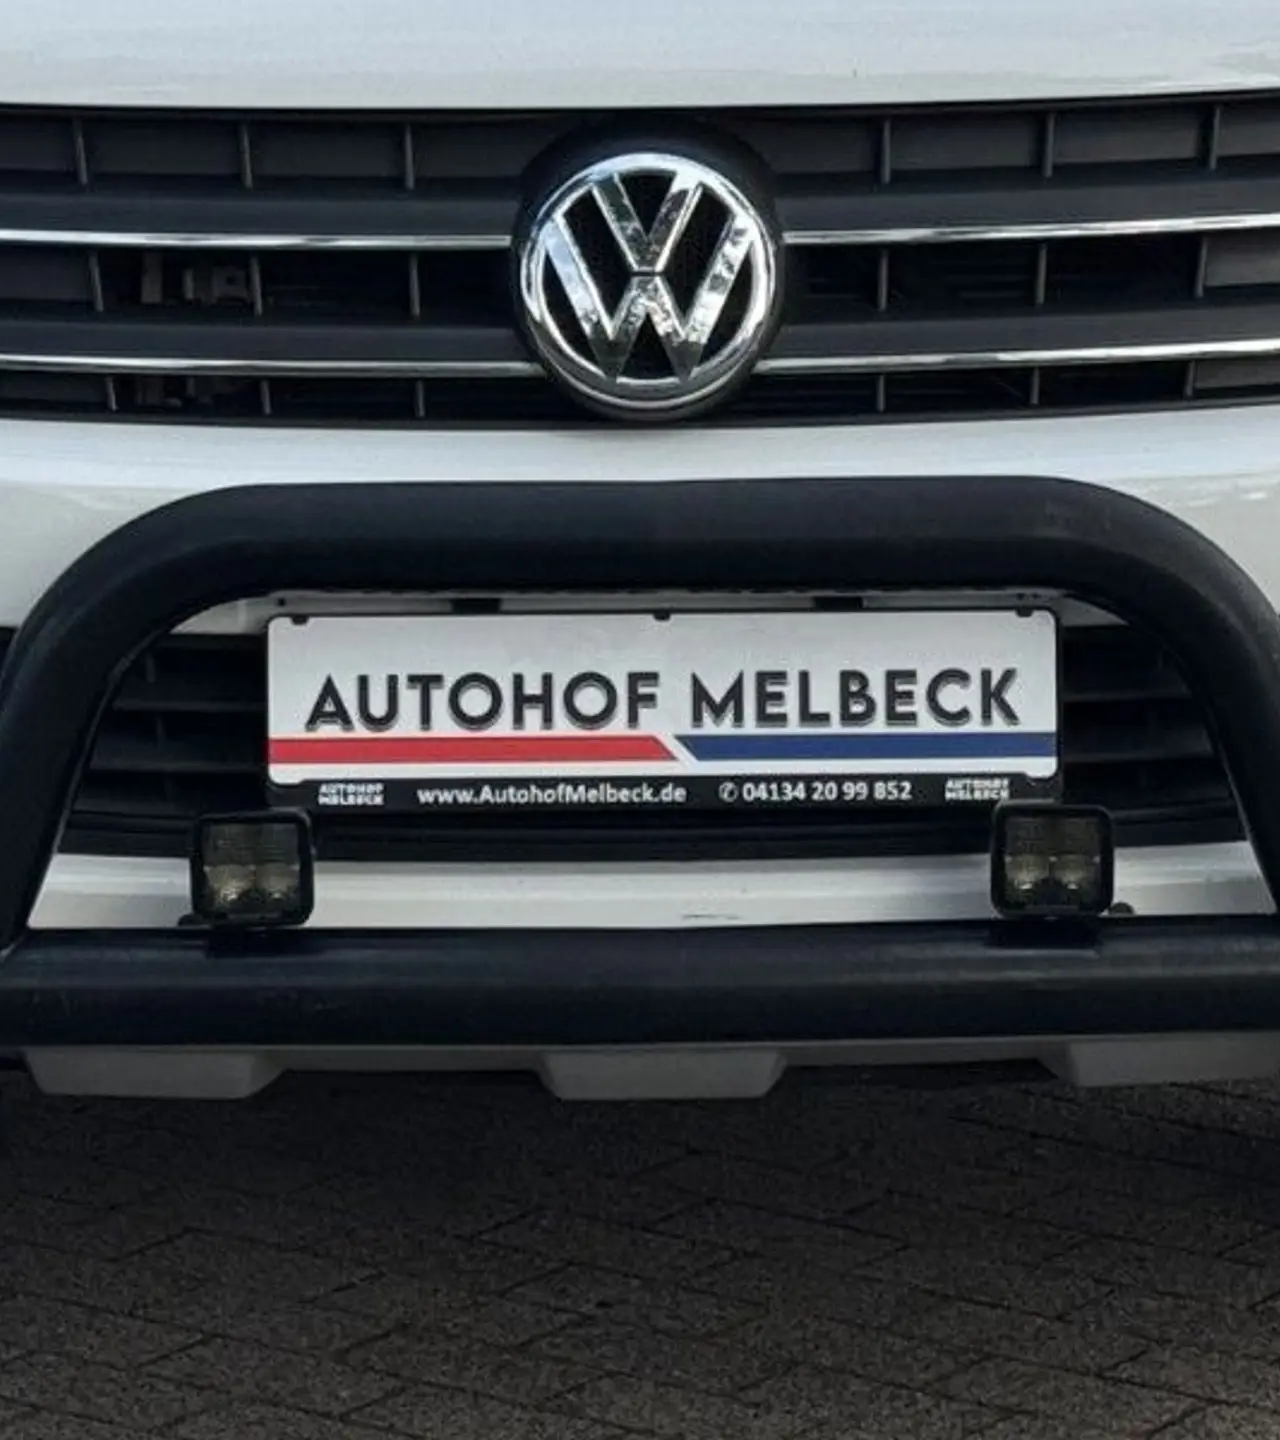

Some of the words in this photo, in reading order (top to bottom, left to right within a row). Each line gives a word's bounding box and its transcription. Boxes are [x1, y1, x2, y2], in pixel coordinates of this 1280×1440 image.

[305, 671, 660, 732] AUTOHOF
[690, 667, 1020, 728] MELBECK
[416, 781, 687, 804] www.AutohofMelbeck.de
[742, 780, 806, 802] 04134
[811, 780, 838, 801] 20
[842, 779, 869, 801] 99
[873, 778, 912, 801] 852
